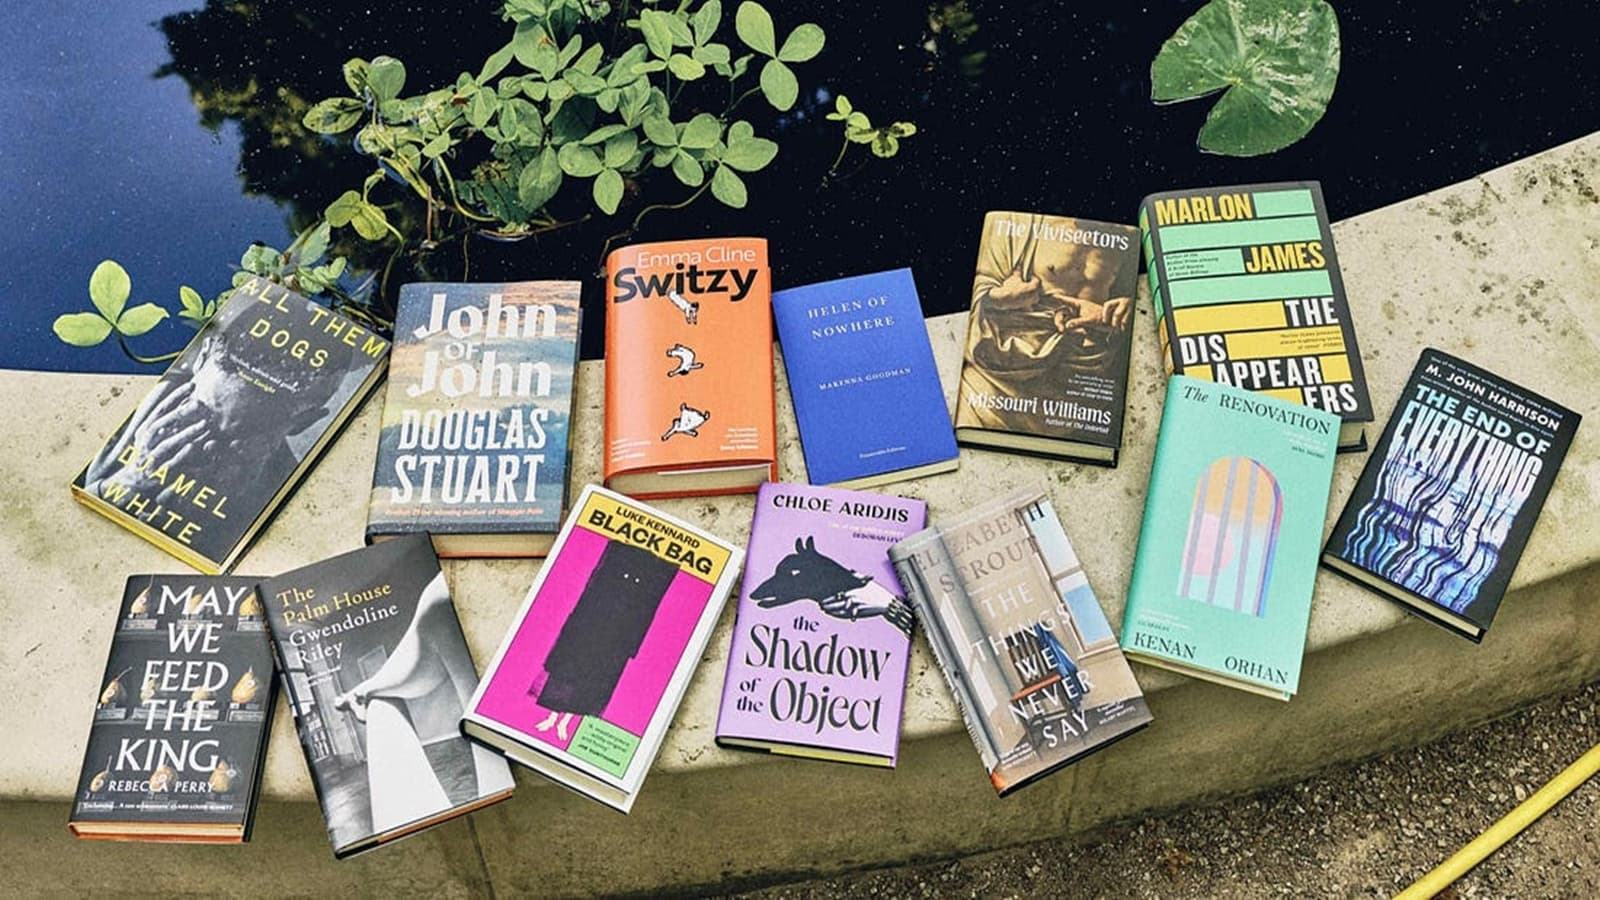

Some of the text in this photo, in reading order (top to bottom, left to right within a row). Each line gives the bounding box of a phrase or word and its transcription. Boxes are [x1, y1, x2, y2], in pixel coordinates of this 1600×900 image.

[1155, 193, 1253, 226] MARLON
[995, 220, 1129, 250] The Vivisectors
[637, 246, 756, 269] Emma Cline
[1246, 242, 1326, 273] JAMES
[613, 263, 758, 304] Switzy
[243, 278, 388, 358] ALL THEM
[413, 293, 557, 340] John
[807, 295, 889, 320] HELEN OF
[1285, 298, 1339, 327] THE
[249, 318, 329, 369] DOGS
[811, 316, 895, 340] NOWHERE
[1180, 334, 1227, 365] DIS
[406, 351, 551, 398] John
[818, 367, 912, 391] MAKENNA GOODMAN
[1215, 356, 1322, 389] APPEAR
[967, 393, 1038, 415] Missouri
[1043, 400, 1112, 425] Williams
[1184, 385, 1331, 435] The RENOVATION
[1304, 385, 1358, 413] ERS
[1425, 363, 1442, 378] M.
[1446, 373, 1486, 397] JOHN
[1488, 391, 1560, 431] HARRISON
[397, 408, 549, 451] DOUGLAS
[1416, 383, 1457, 415] THE
[1462, 404, 1512, 439] END
[1515, 431, 1550, 454] OF
[1391, 400, 1543, 499] EVERYTHING
[117, 445, 229, 519] DJAMEL
[391, 454, 545, 505] STUART
[102, 482, 202, 545] WHITE
[773, 494, 909, 523] CHLOE ARIDJIS
[588, 509, 713, 575] BLACK BAG
[615, 505, 701, 549] LUKE KENNARD
[914, 501, 1045, 571] ELZABETH
[157, 585, 248, 616] MAY
[276, 587, 315, 608] The
[282, 583, 392, 627] Palm House
[980, 582, 1034, 618] THE
[167, 622, 223, 654] WE
[288, 602, 400, 647] Gwendoline
[793, 616, 820, 633] the
[973, 603, 1072, 662] THINGS
[296, 641, 343, 666] Riley
[745, 623, 892, 682] Shadow
[1015, 647, 1058, 682] WE
[1133, 632, 1289, 685] KENAN ORHAN
[141, 660, 229, 692] FEED
[142, 699, 219, 731] THE
[737, 695, 764, 713] the
[739, 677, 882, 735] of Object
[1006, 670, 1095, 724] NEVER
[1042, 710, 1090, 748] SAY
[115, 738, 220, 772] KING
[108, 780, 216, 794] REBECCA PERRY
